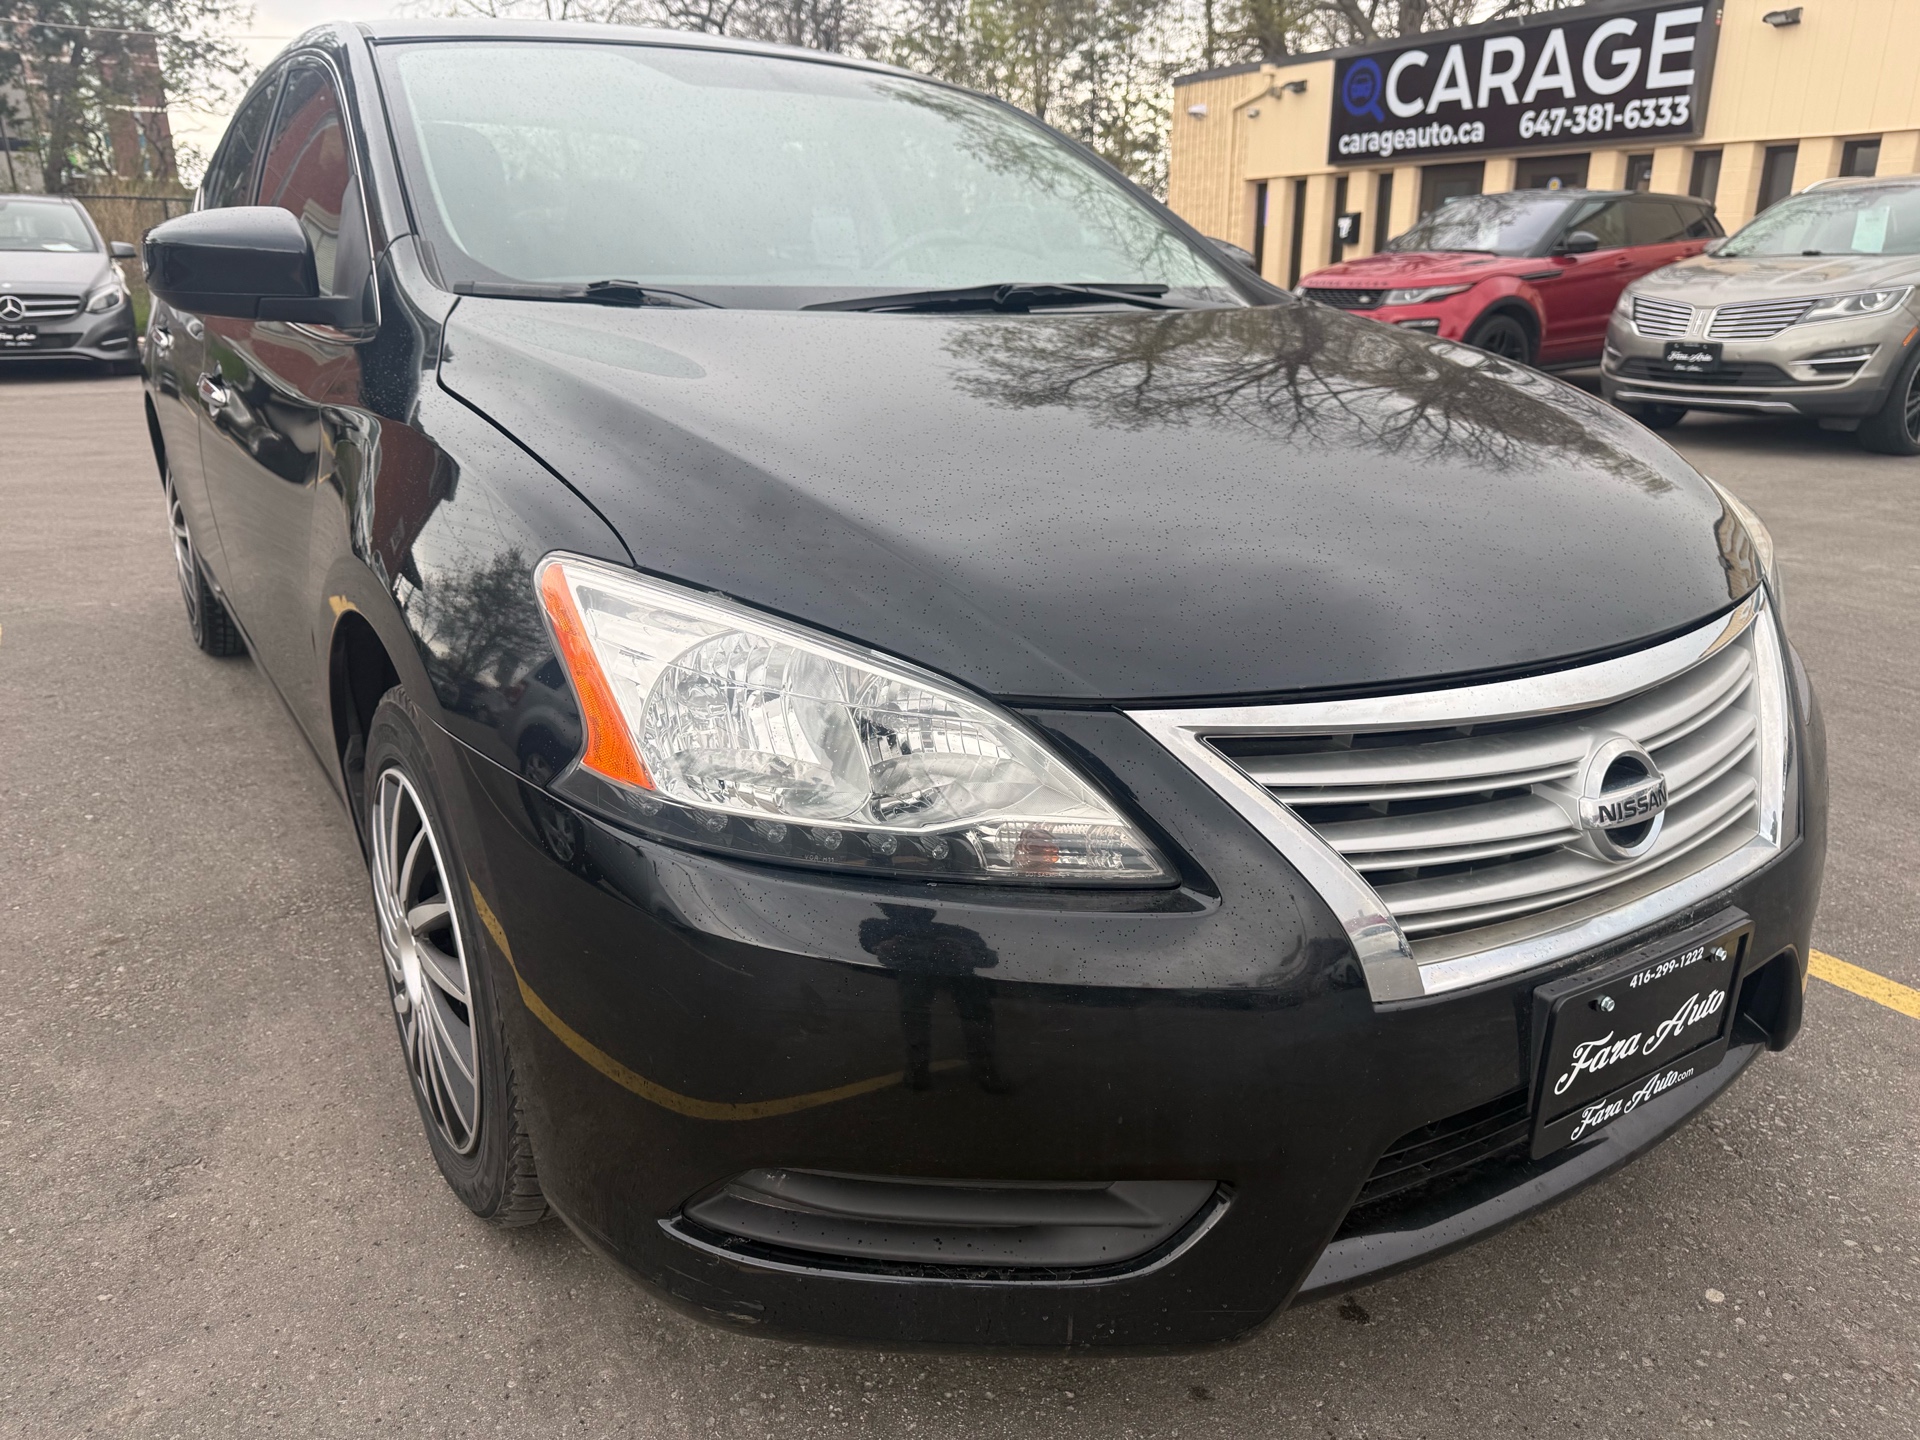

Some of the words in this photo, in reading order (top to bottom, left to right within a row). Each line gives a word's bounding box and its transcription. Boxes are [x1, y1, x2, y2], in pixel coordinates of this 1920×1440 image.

[1385, 7, 1704, 118] CARAGE
[1338, 121, 1485, 157] carageauto.ca
[1519, 95, 1691, 139] 647-381-6333
[1598, 780, 1667, 823] NISSAN
[1629, 947, 1705, 988] 416-299-1222
[1554, 1031, 1642, 1095] Fara
[1642, 989, 1725, 1055] Auto
[1570, 1099, 1623, 1140] Fara
[1624, 1067, 1694, 1114] Auto.com
